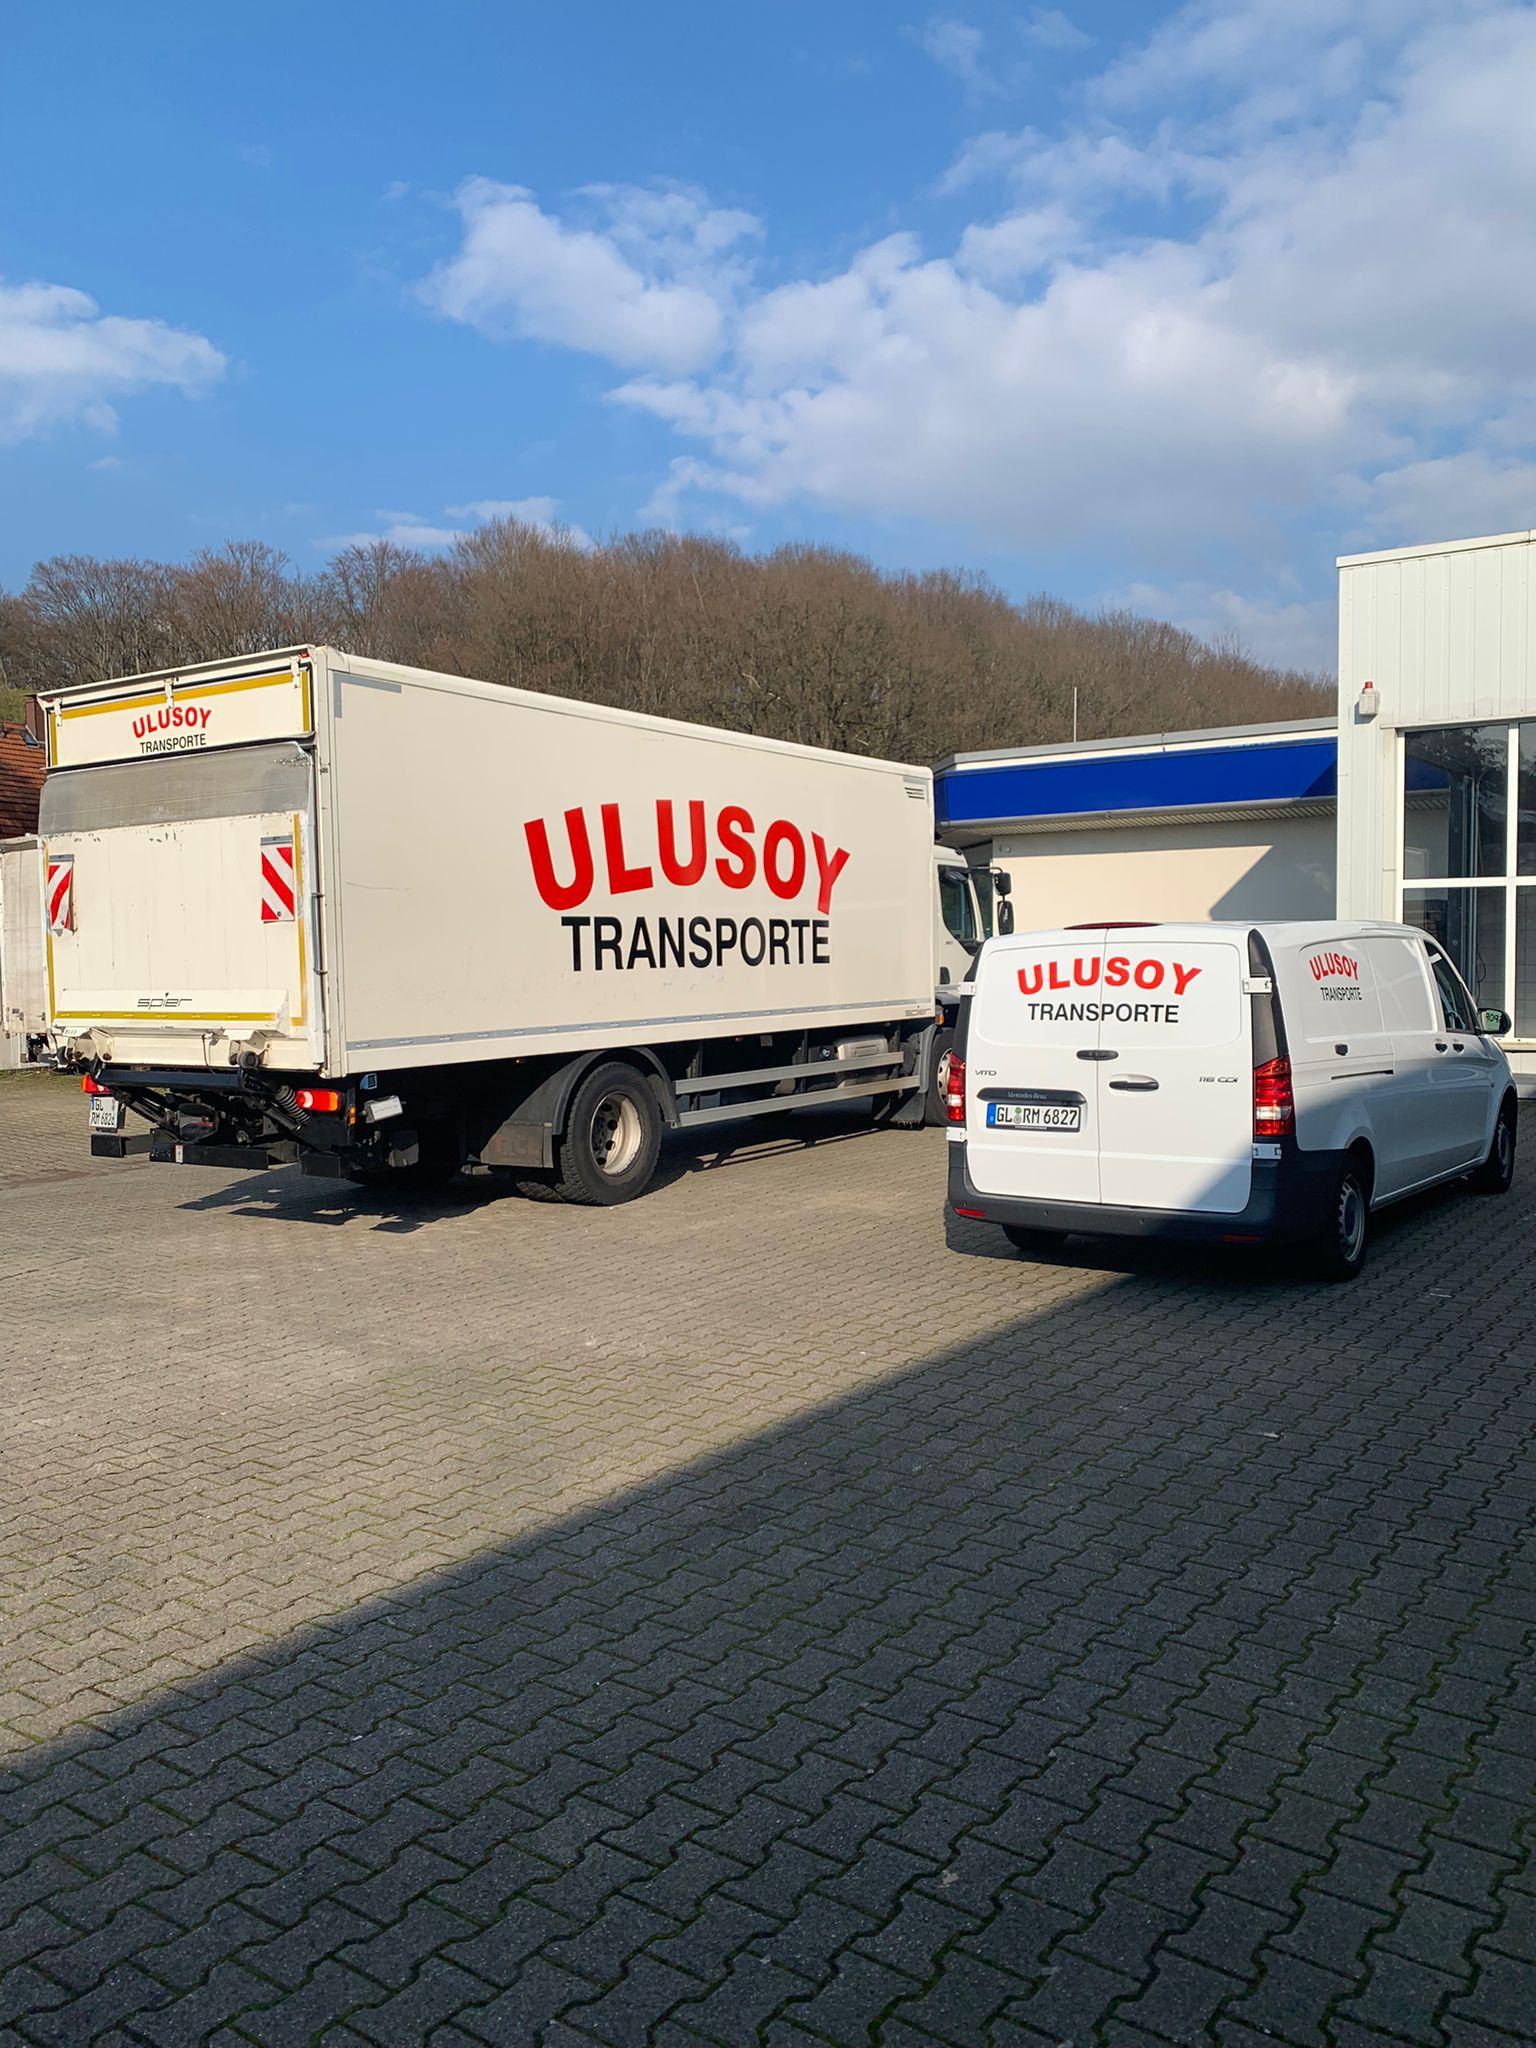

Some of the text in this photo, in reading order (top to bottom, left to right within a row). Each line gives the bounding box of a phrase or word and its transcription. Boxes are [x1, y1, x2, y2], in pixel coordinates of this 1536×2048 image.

[132, 706, 212, 738] ULUSOY
[140, 733, 206, 753] TRANSPORTE
[524, 799, 850, 915] ULUSOY
[561, 916, 830, 971] TRANSPORTE
[1017, 956, 1203, 996] ULUSOY
[1309, 952, 1358, 981] ULUSOY
[137, 992, 192, 1010] spier
[1320, 987, 1362, 1001] TRANSPORTE
[1028, 1003, 1179, 1024] TRANSPORTE
[1008, 1091, 1048, 1100] Mercedes-Benz
[997, 1106, 1078, 1126] GL RM 6827
